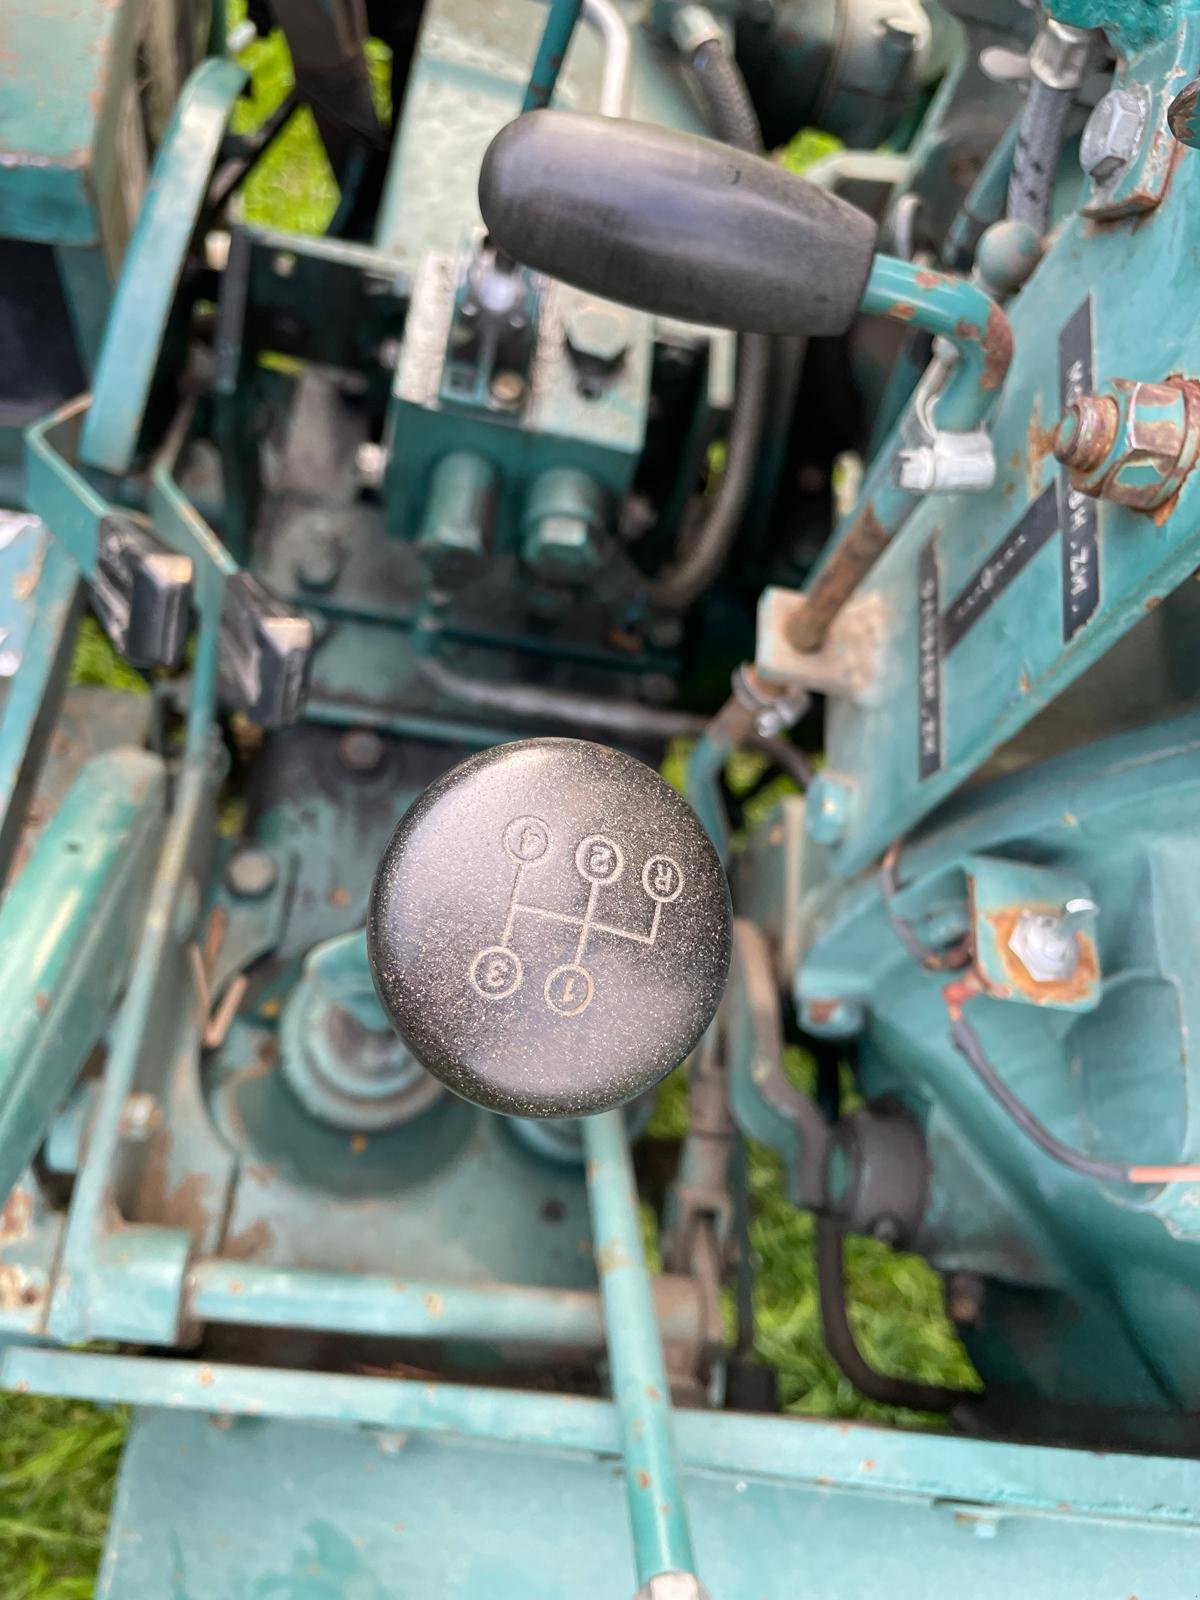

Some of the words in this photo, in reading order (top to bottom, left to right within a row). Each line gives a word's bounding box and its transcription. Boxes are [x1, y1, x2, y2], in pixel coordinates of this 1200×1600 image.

[589, 844, 611, 873] 2
[654, 862, 672, 892] R
[486, 959, 508, 987] 3
